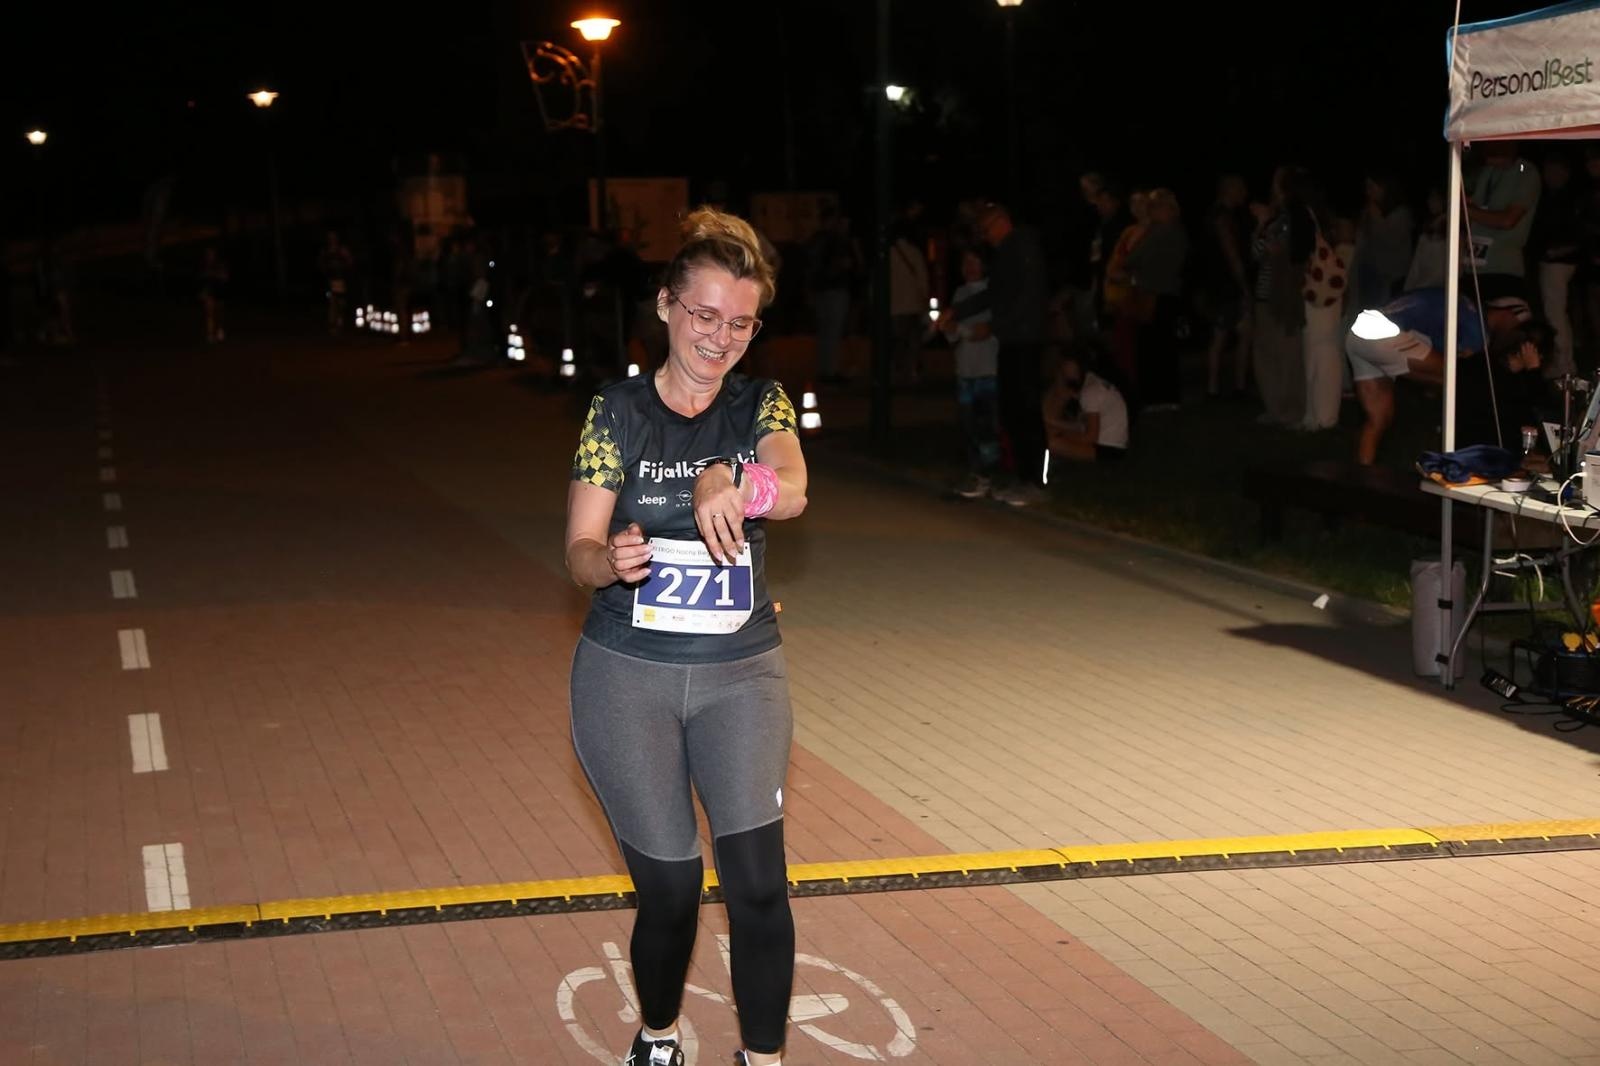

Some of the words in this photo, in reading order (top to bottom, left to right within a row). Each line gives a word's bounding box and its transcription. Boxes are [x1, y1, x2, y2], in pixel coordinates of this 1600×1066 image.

[1470, 57, 1593, 100] PersonalBest
[638, 494, 667, 506] Jeep
[655, 566, 735, 607] 271
